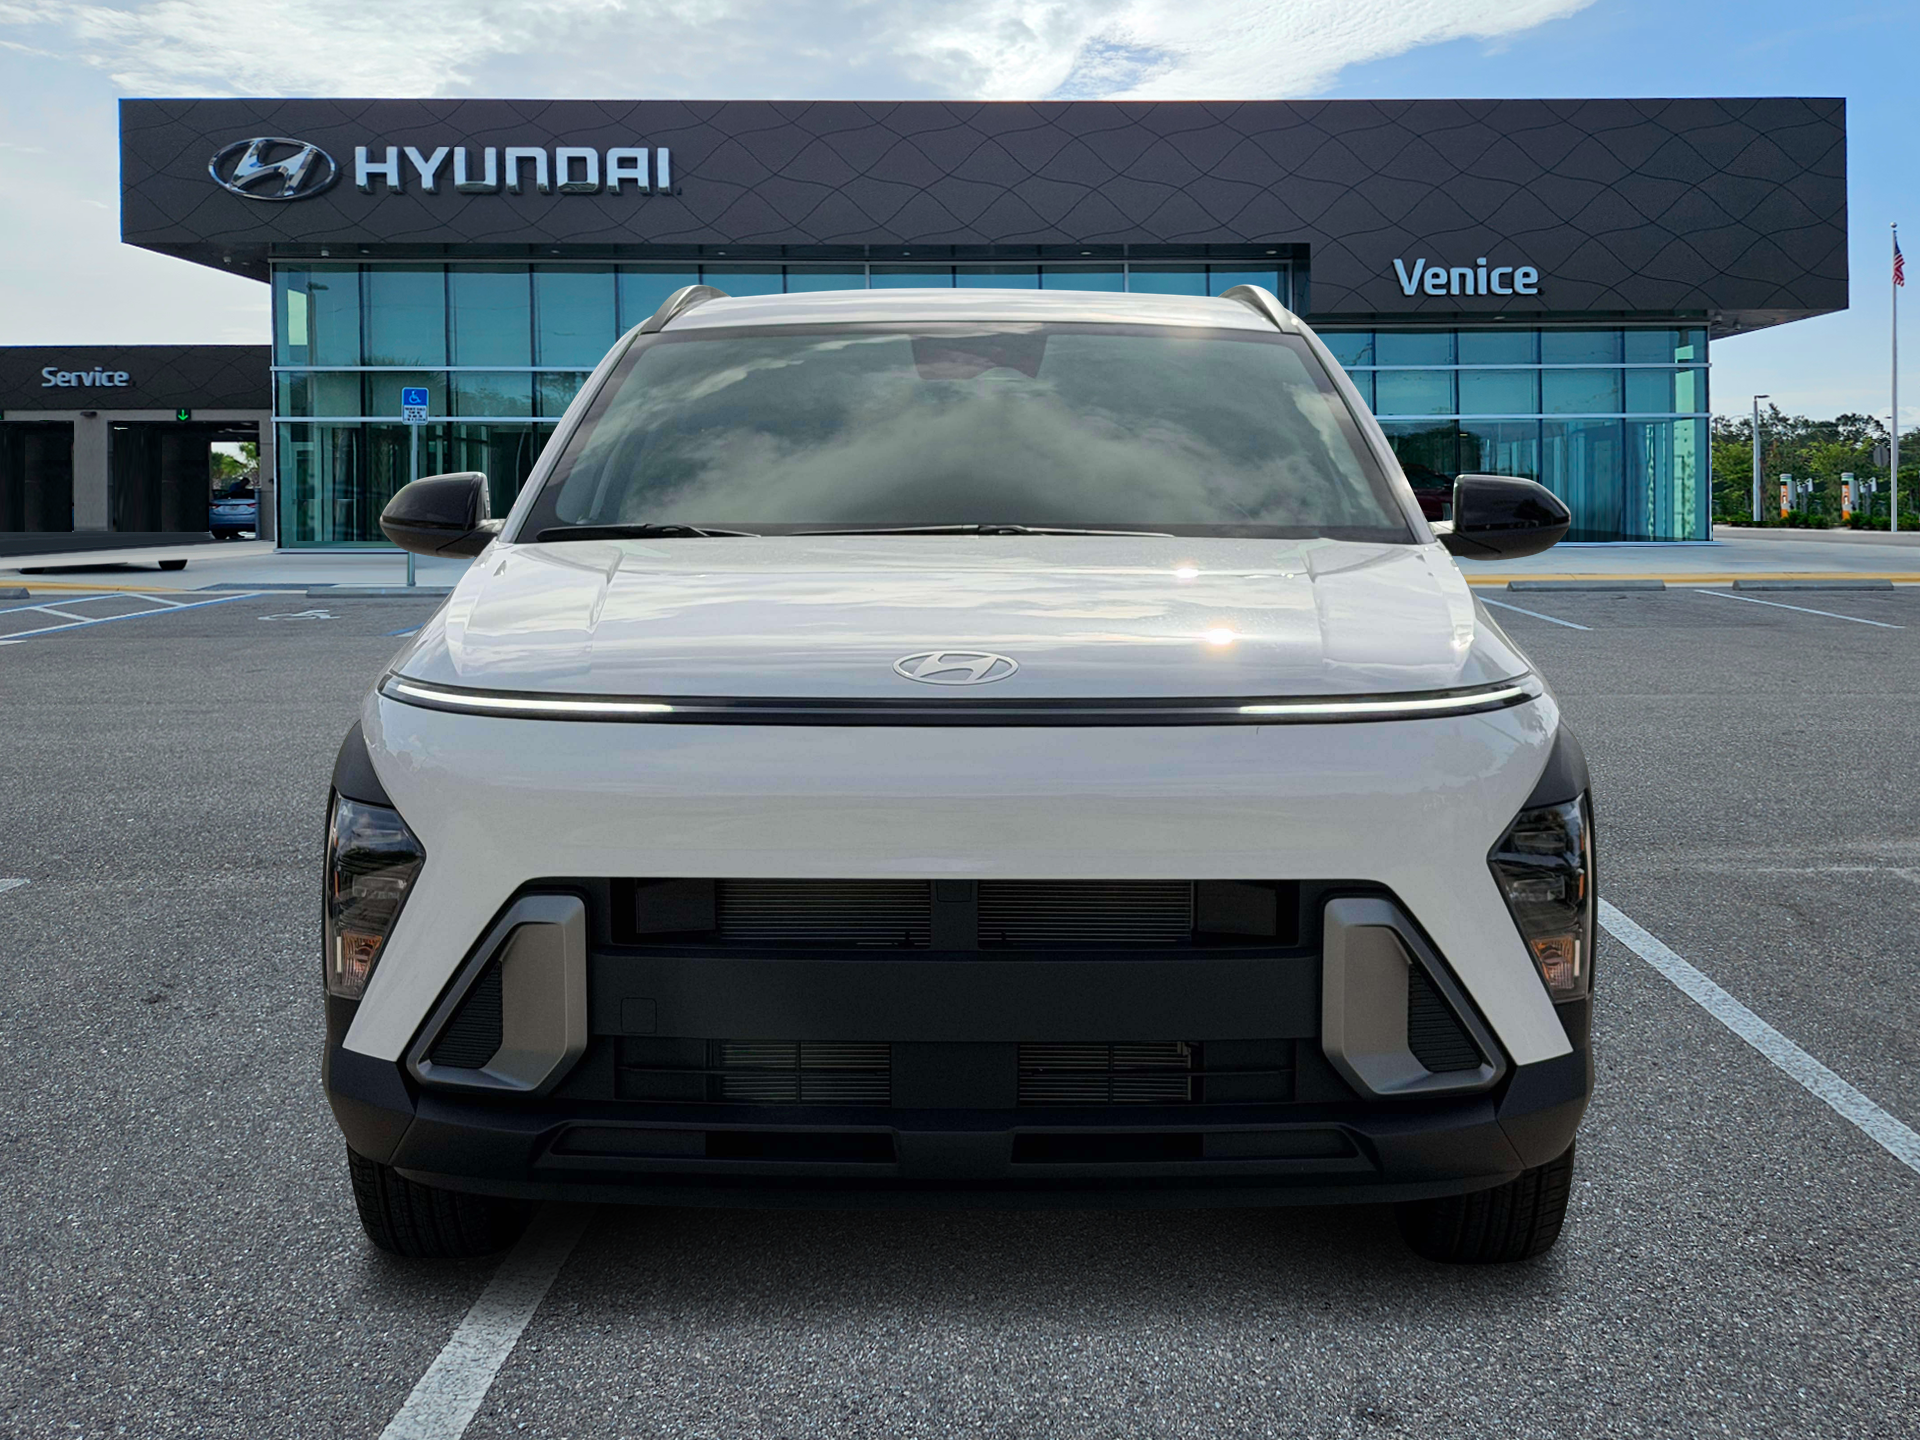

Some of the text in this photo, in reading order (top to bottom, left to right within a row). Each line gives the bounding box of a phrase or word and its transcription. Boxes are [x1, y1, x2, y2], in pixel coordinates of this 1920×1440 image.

[355, 146, 672, 194] HYUNDAI
[1393, 257, 1539, 296] Venice
[41, 366, 130, 387] Service
